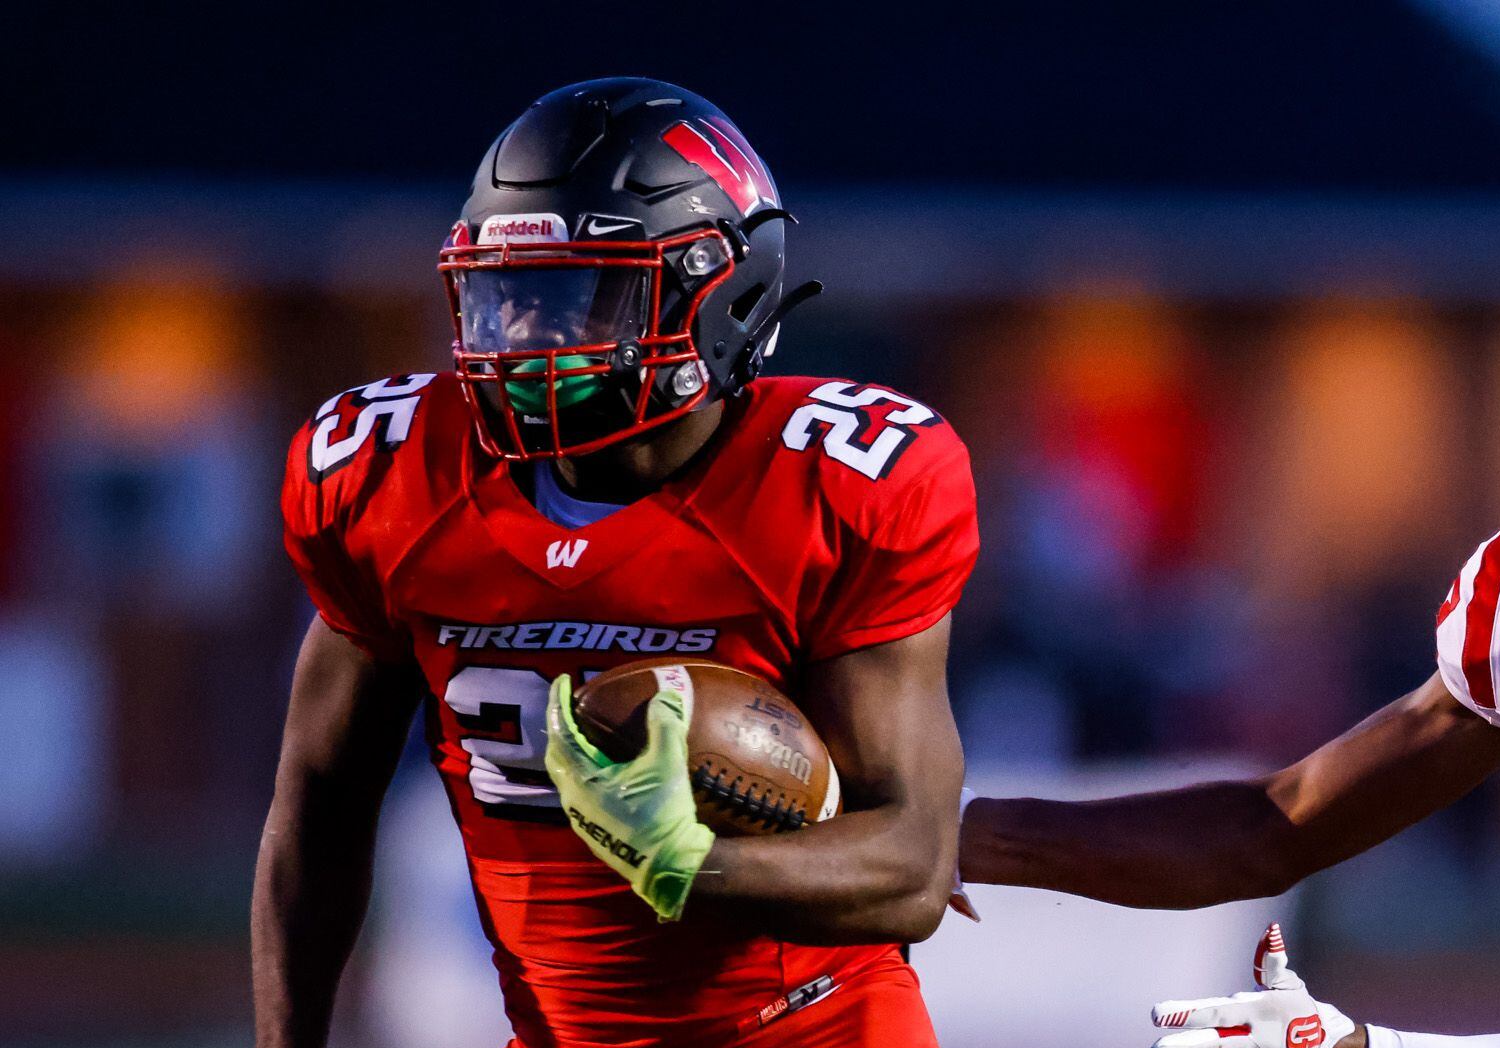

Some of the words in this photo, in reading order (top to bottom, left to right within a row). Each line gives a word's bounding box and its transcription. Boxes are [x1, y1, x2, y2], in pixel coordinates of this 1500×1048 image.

[781, 381, 936, 482] 25
[546, 538, 588, 570] W
[436, 621, 718, 653] FIREBIRDS
